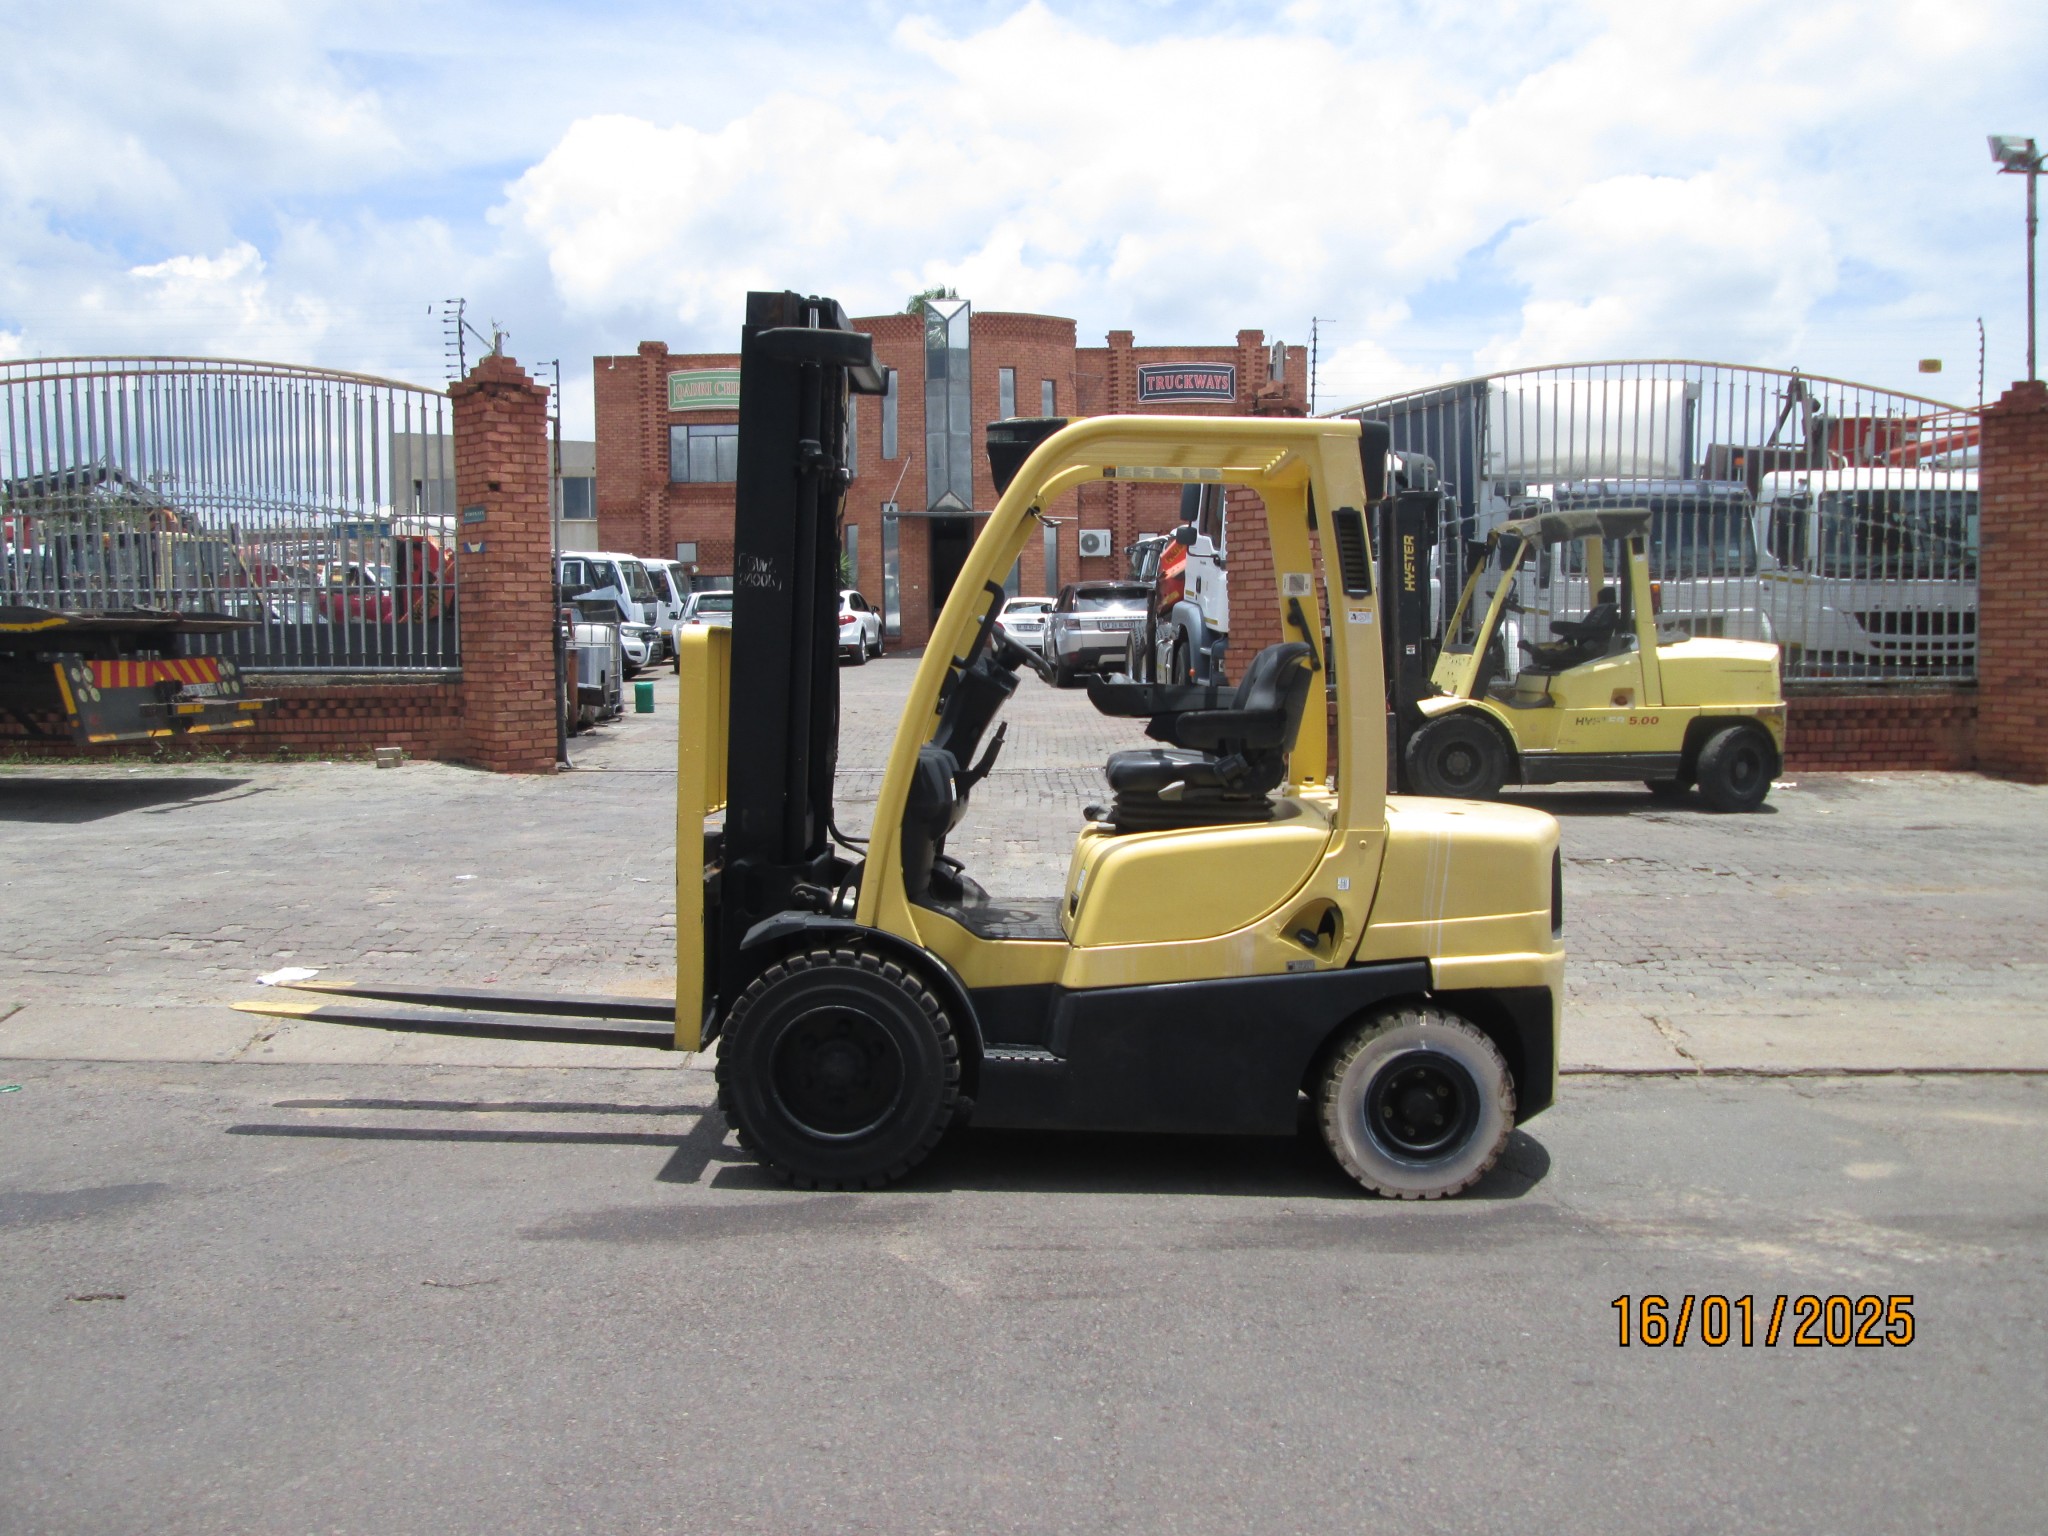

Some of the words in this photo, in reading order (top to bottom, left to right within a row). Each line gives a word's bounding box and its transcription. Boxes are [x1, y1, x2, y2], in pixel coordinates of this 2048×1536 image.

[1146, 374, 1229, 390] TRUCKWAYS
[1403, 534, 1416, 592] HYSTER
[1575, 716, 1626, 726] HYSER
[1628, 716, 1660, 726] 5.00
